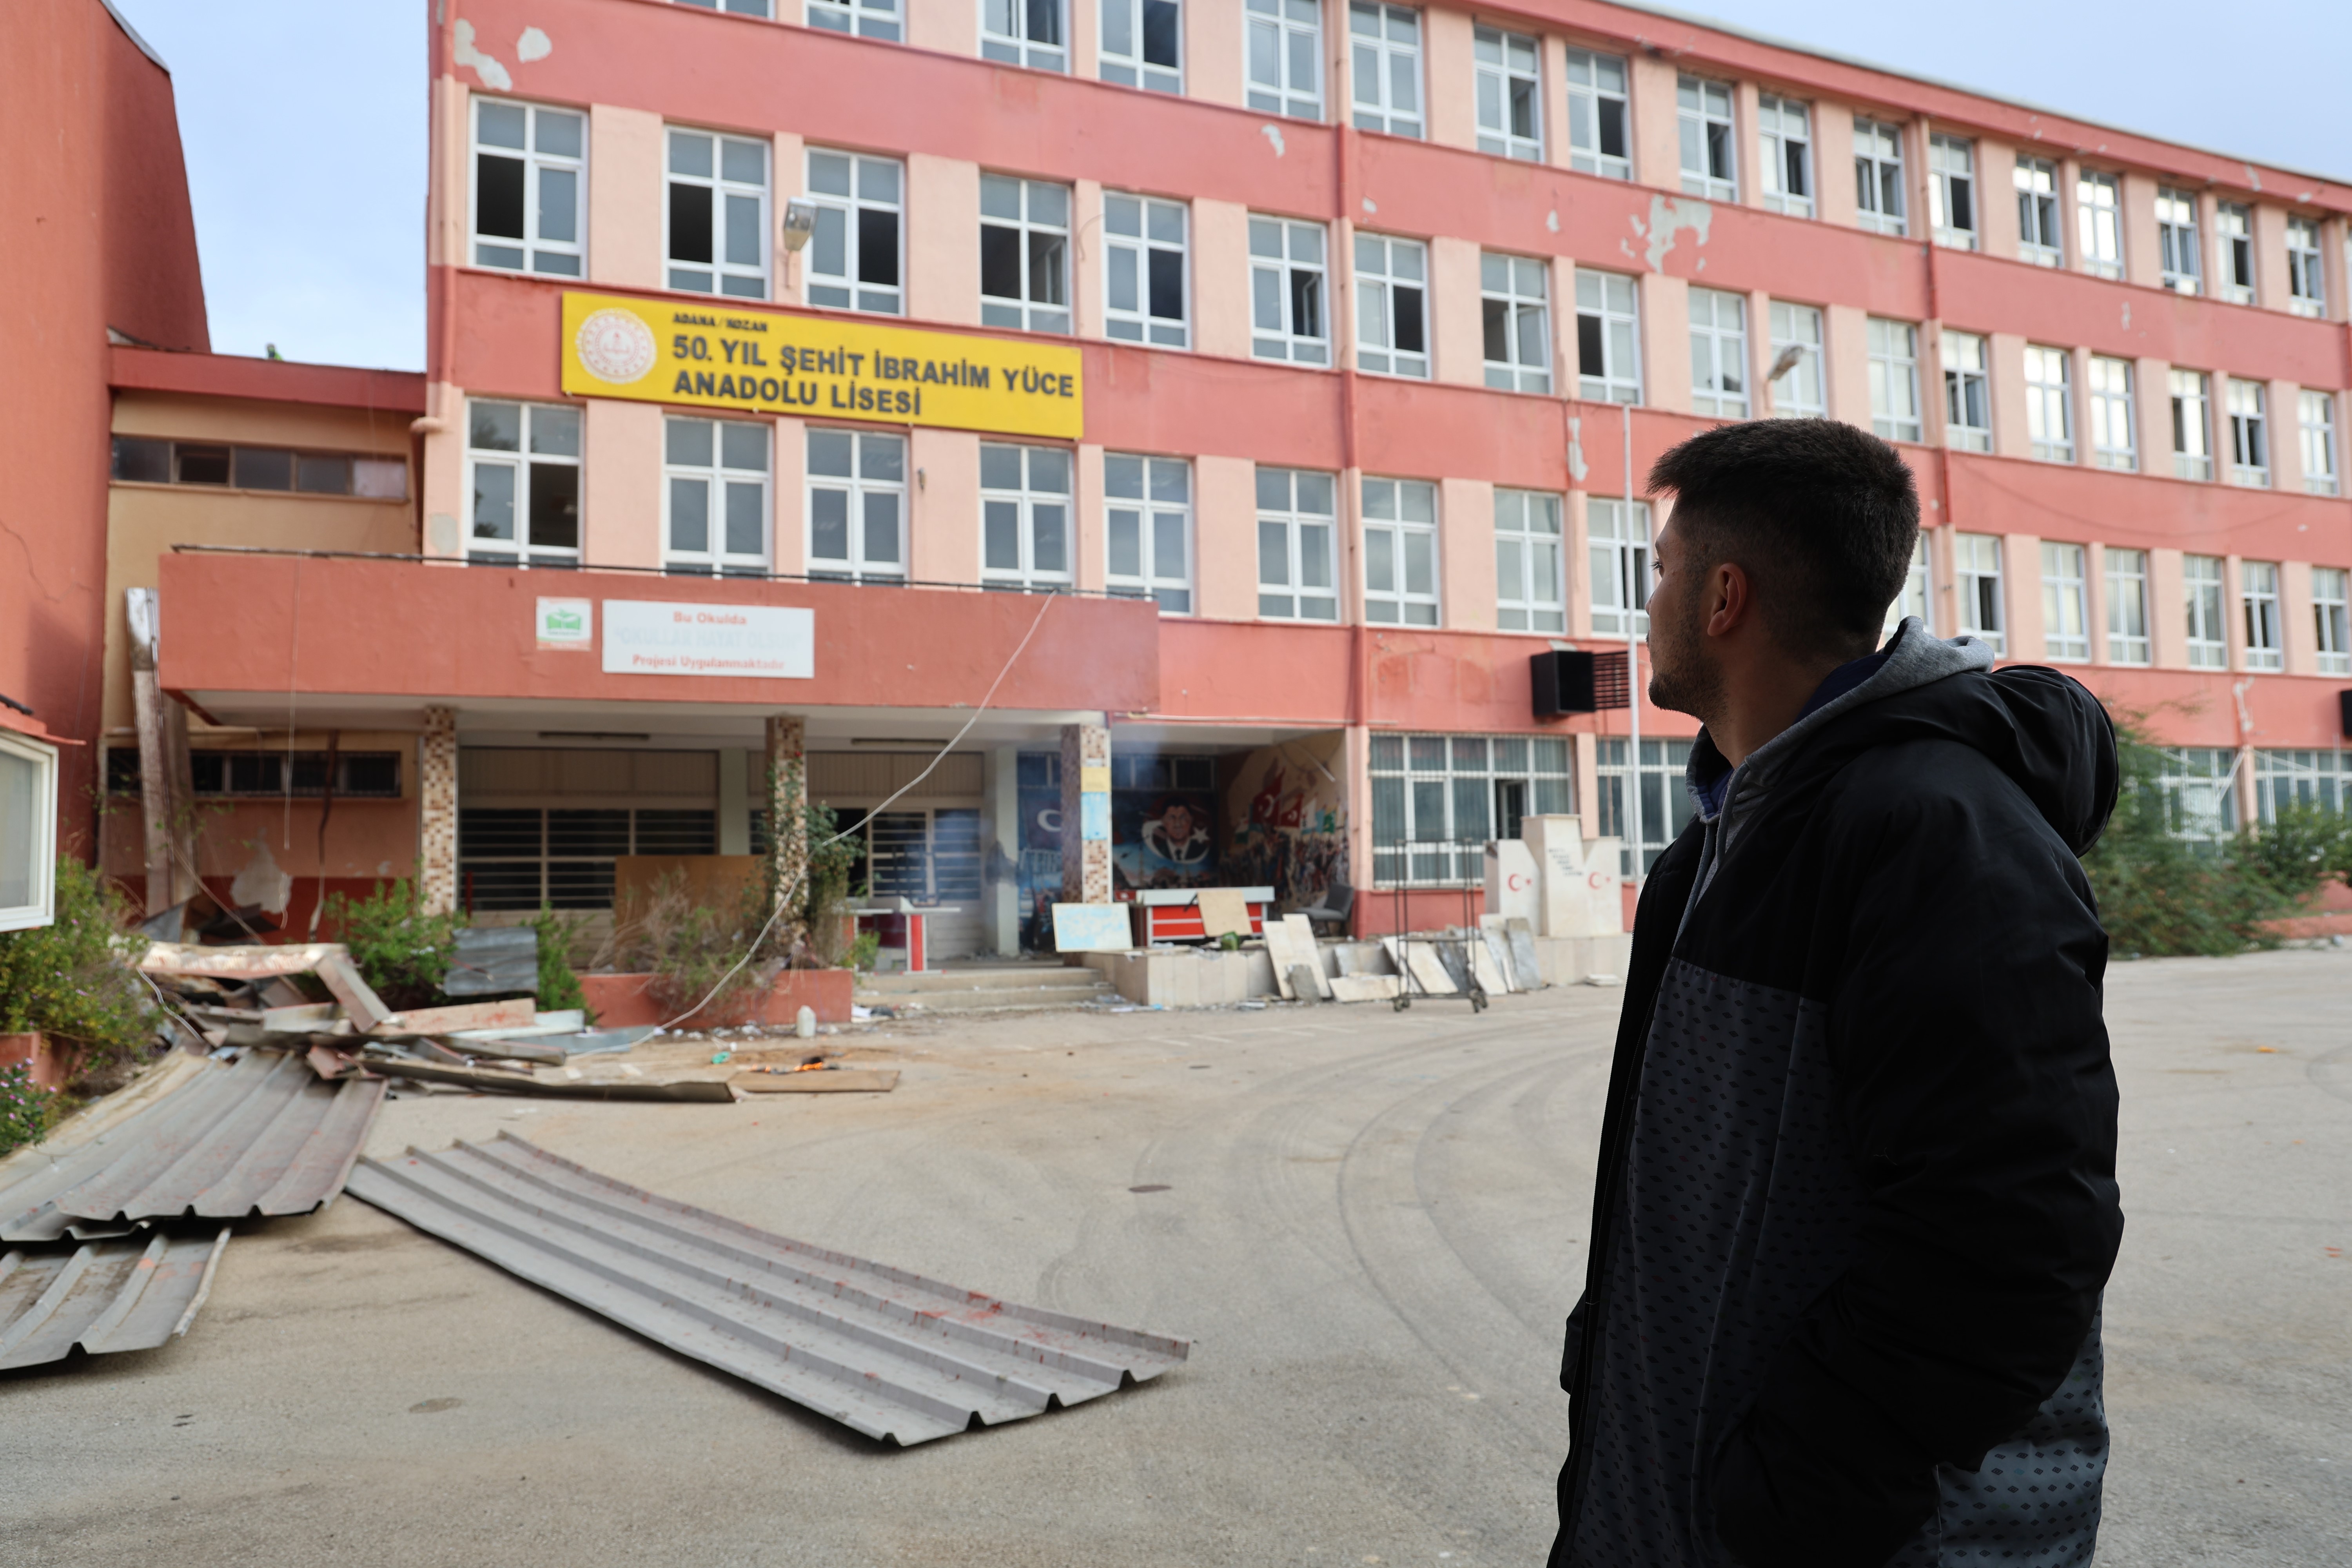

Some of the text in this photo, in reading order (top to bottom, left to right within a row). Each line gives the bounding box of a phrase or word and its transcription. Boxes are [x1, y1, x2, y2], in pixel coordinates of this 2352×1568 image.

[673, 312, 715, 327] ADANA
[673, 334, 1073, 397] 50. YIL ŞEHİT İBRAHİM YÜCE
[674, 369, 920, 415] ANADOLU LİSESİ
[673, 611, 747, 626] Bu Okulda
[632, 654, 677, 668] Projesi
